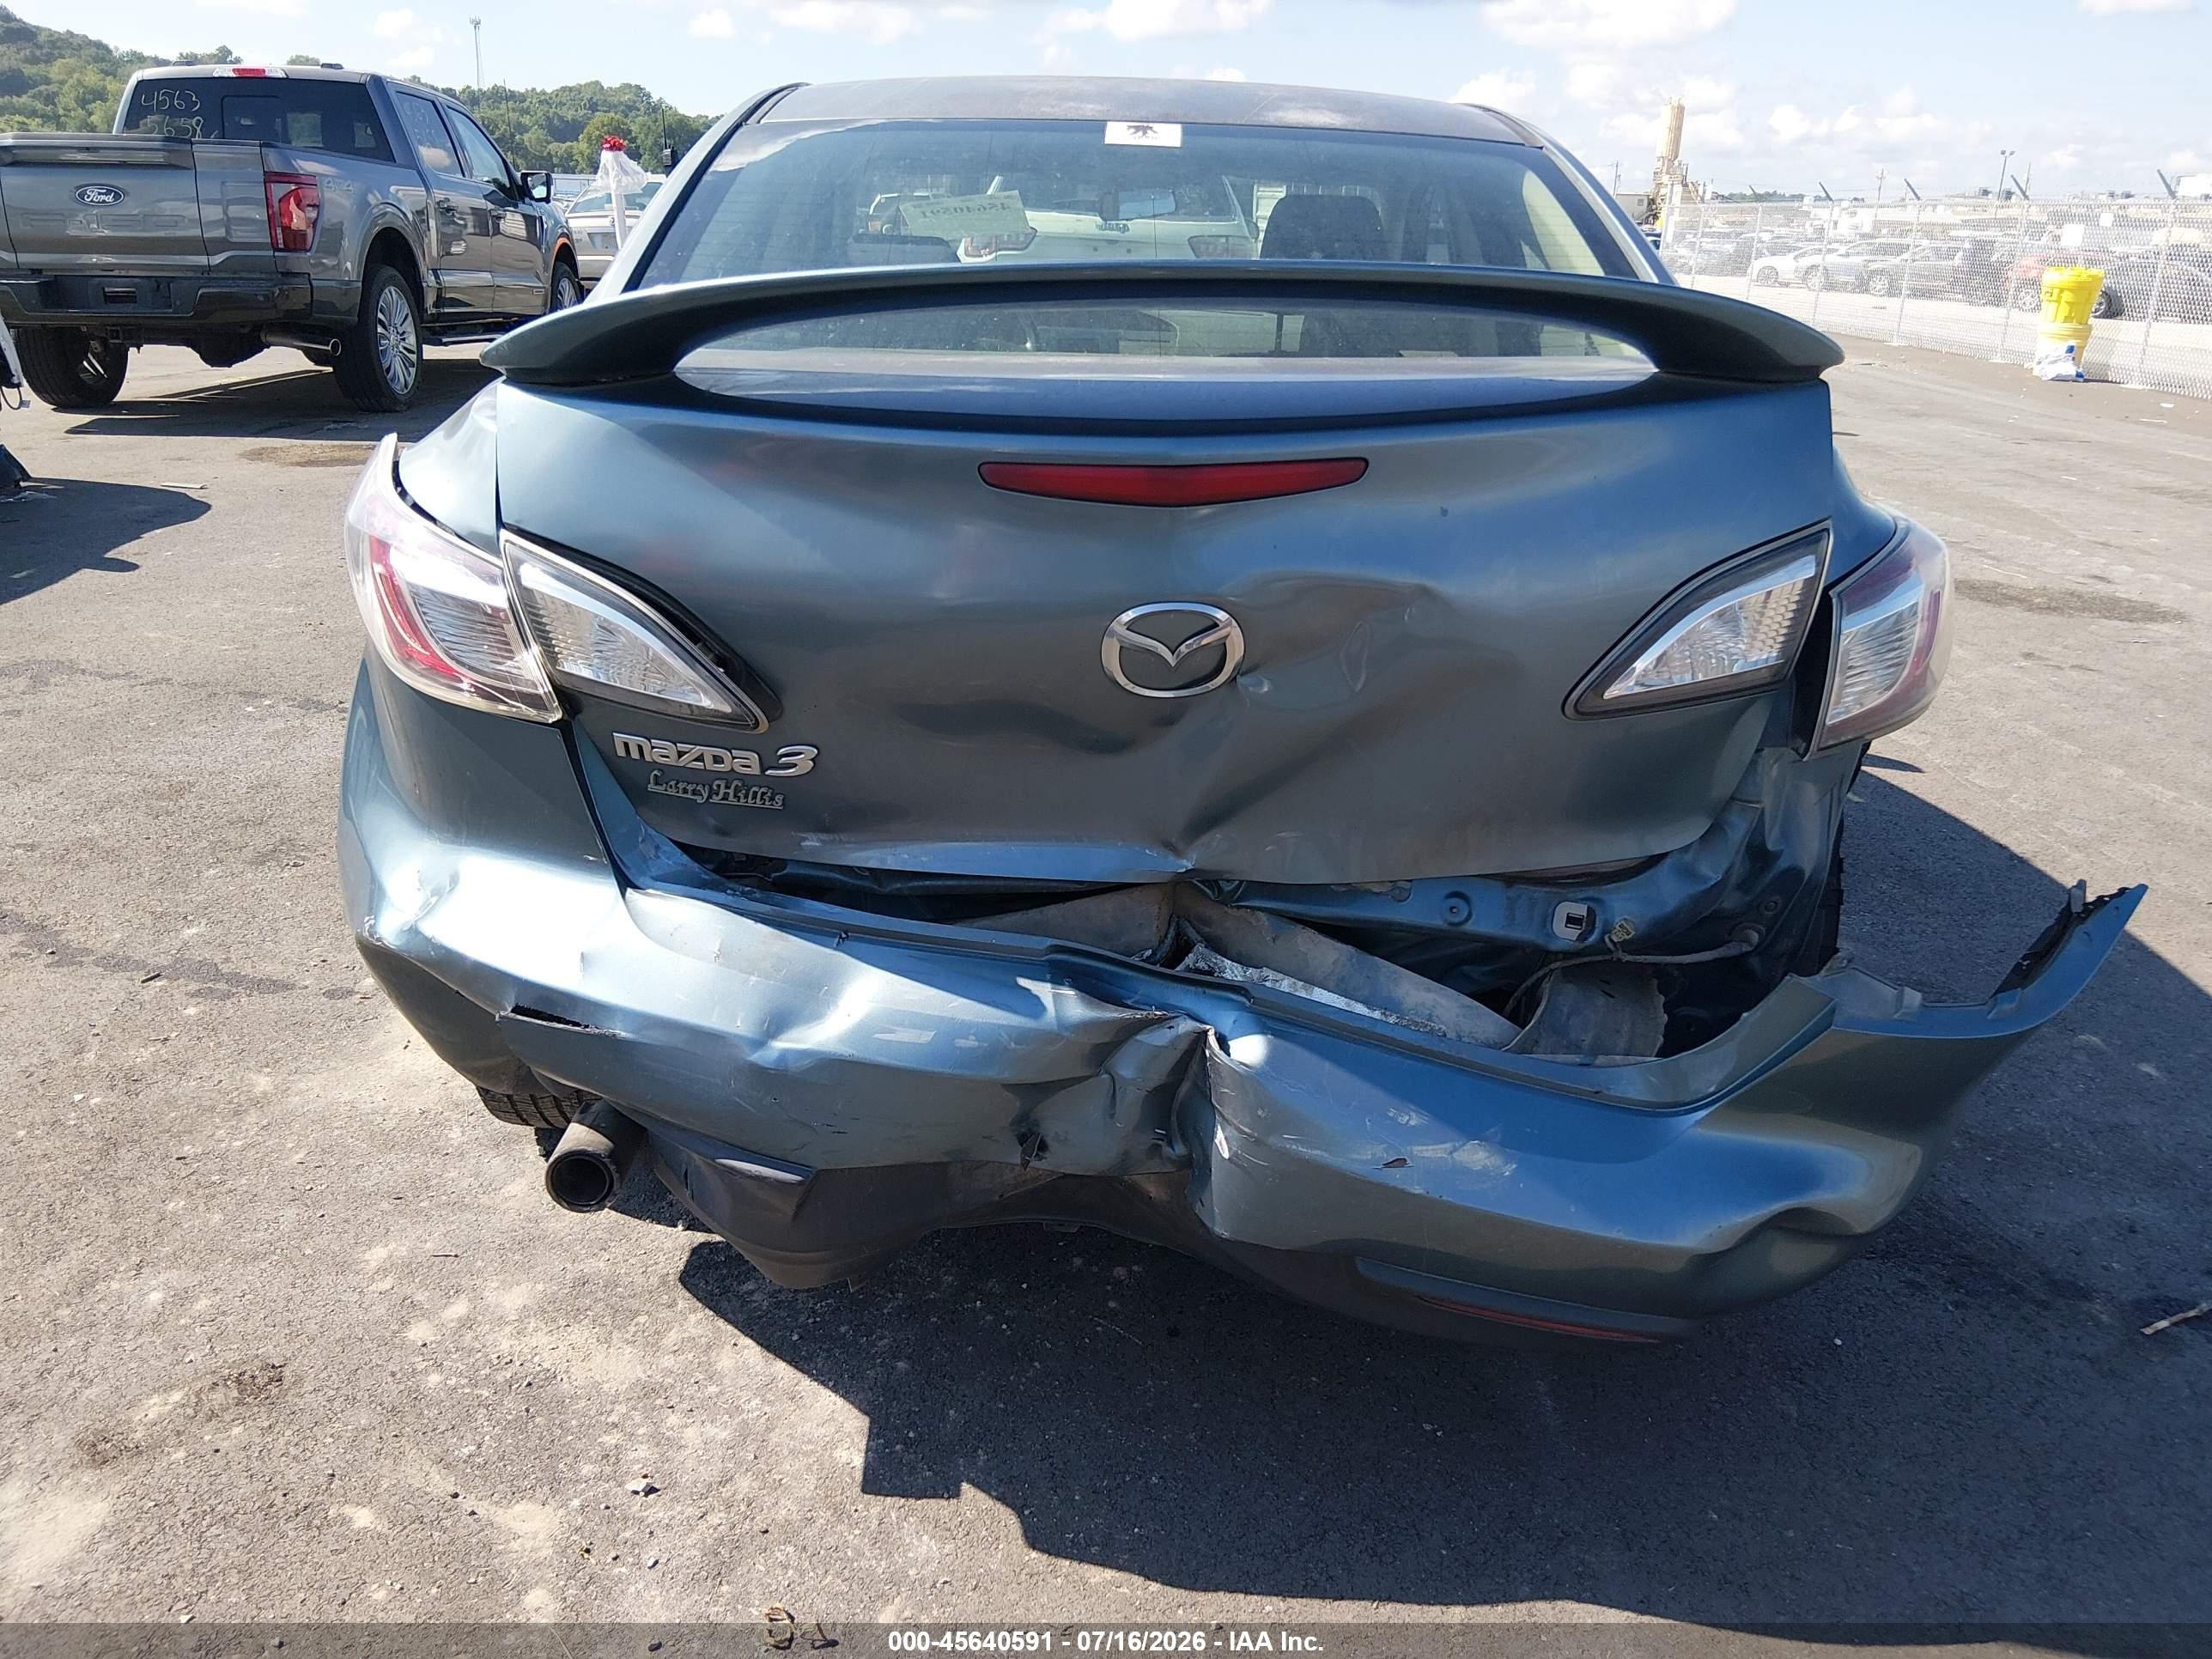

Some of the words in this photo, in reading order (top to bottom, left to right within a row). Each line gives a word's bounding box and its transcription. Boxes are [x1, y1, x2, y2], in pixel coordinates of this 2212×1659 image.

[141, 88, 201, 112] 4563
[763, 744, 819, 778] 3
[647, 769, 711, 804] Larry
[710, 779, 784, 810] Hillis
